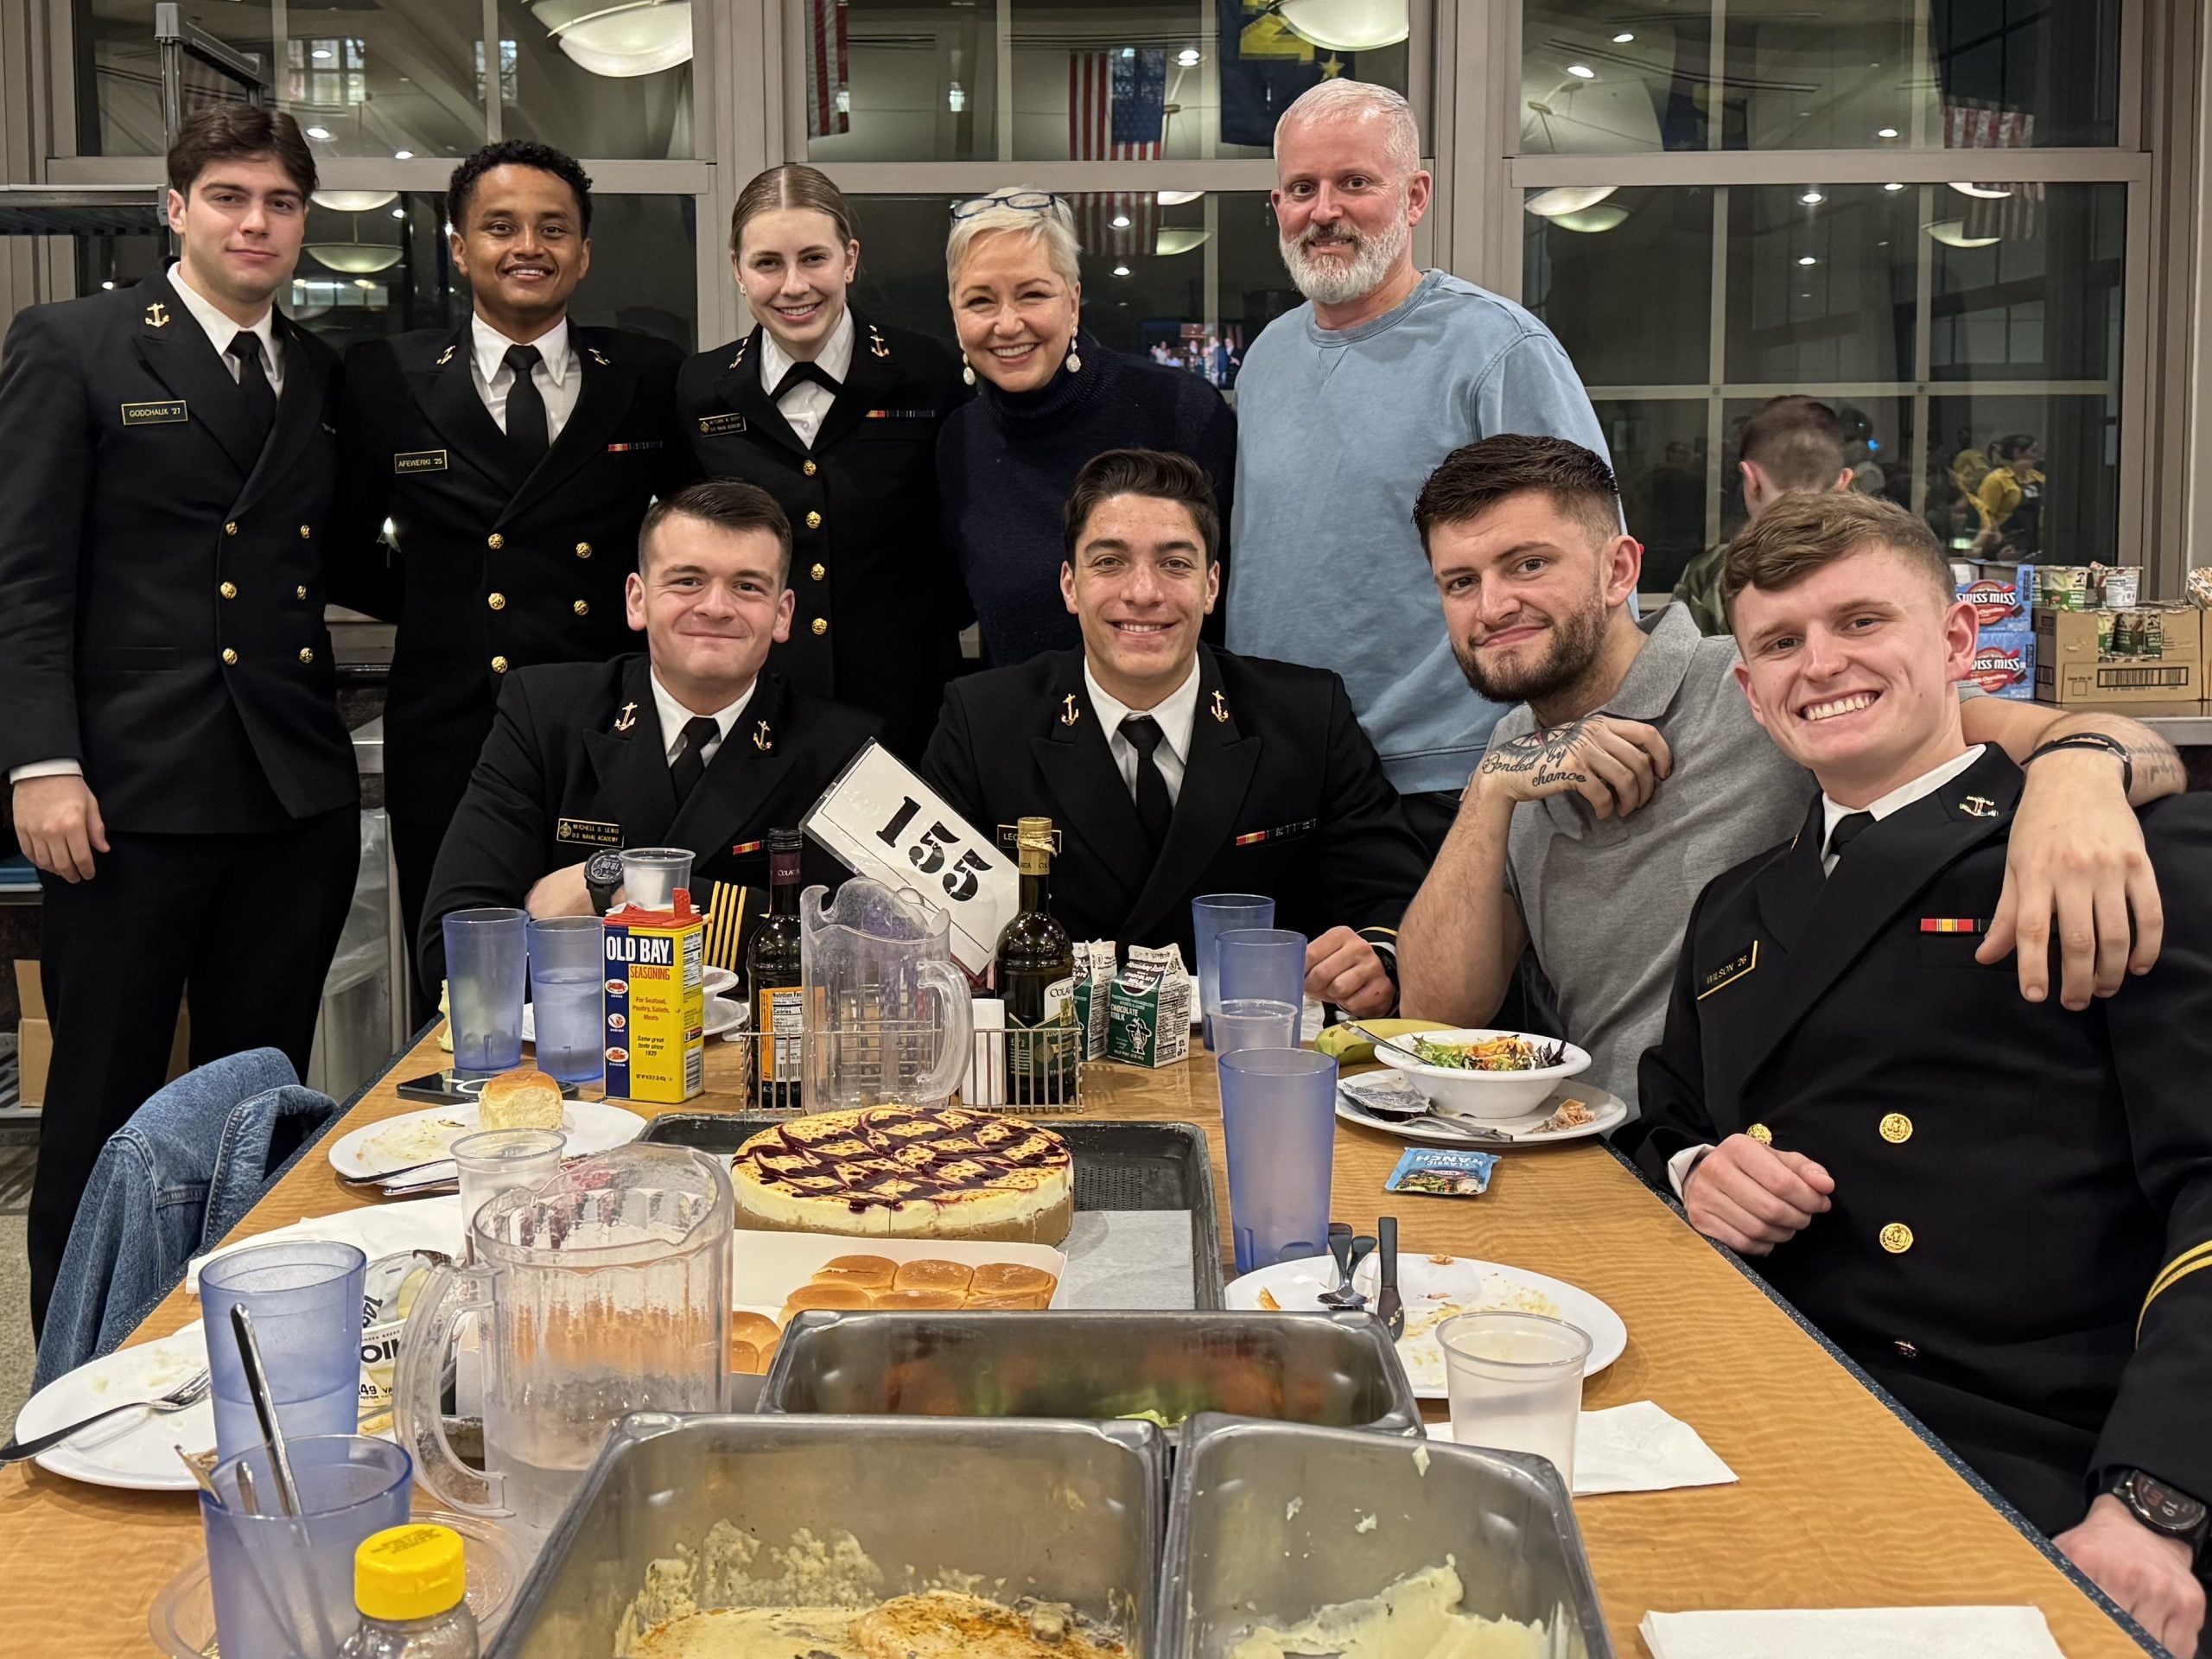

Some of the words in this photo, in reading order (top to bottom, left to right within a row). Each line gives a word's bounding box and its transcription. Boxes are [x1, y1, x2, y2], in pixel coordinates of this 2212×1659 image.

[129, 409, 169, 417] GODCHAUX
[1956, 592, 1988, 605] SWISS
[1482, 750, 1543, 774] Bonded
[1547, 746, 1567, 768] by
[1532, 764, 1587, 787] chance
[875, 795, 994, 902] 155
[606, 936, 637, 962] OLD
[639, 938, 671, 964] BAY
[630, 966, 671, 981] SEASONING
[1110, 1003, 1139, 1017] CHOCOLATE
[1415, 1154, 1484, 1167] RANCH
